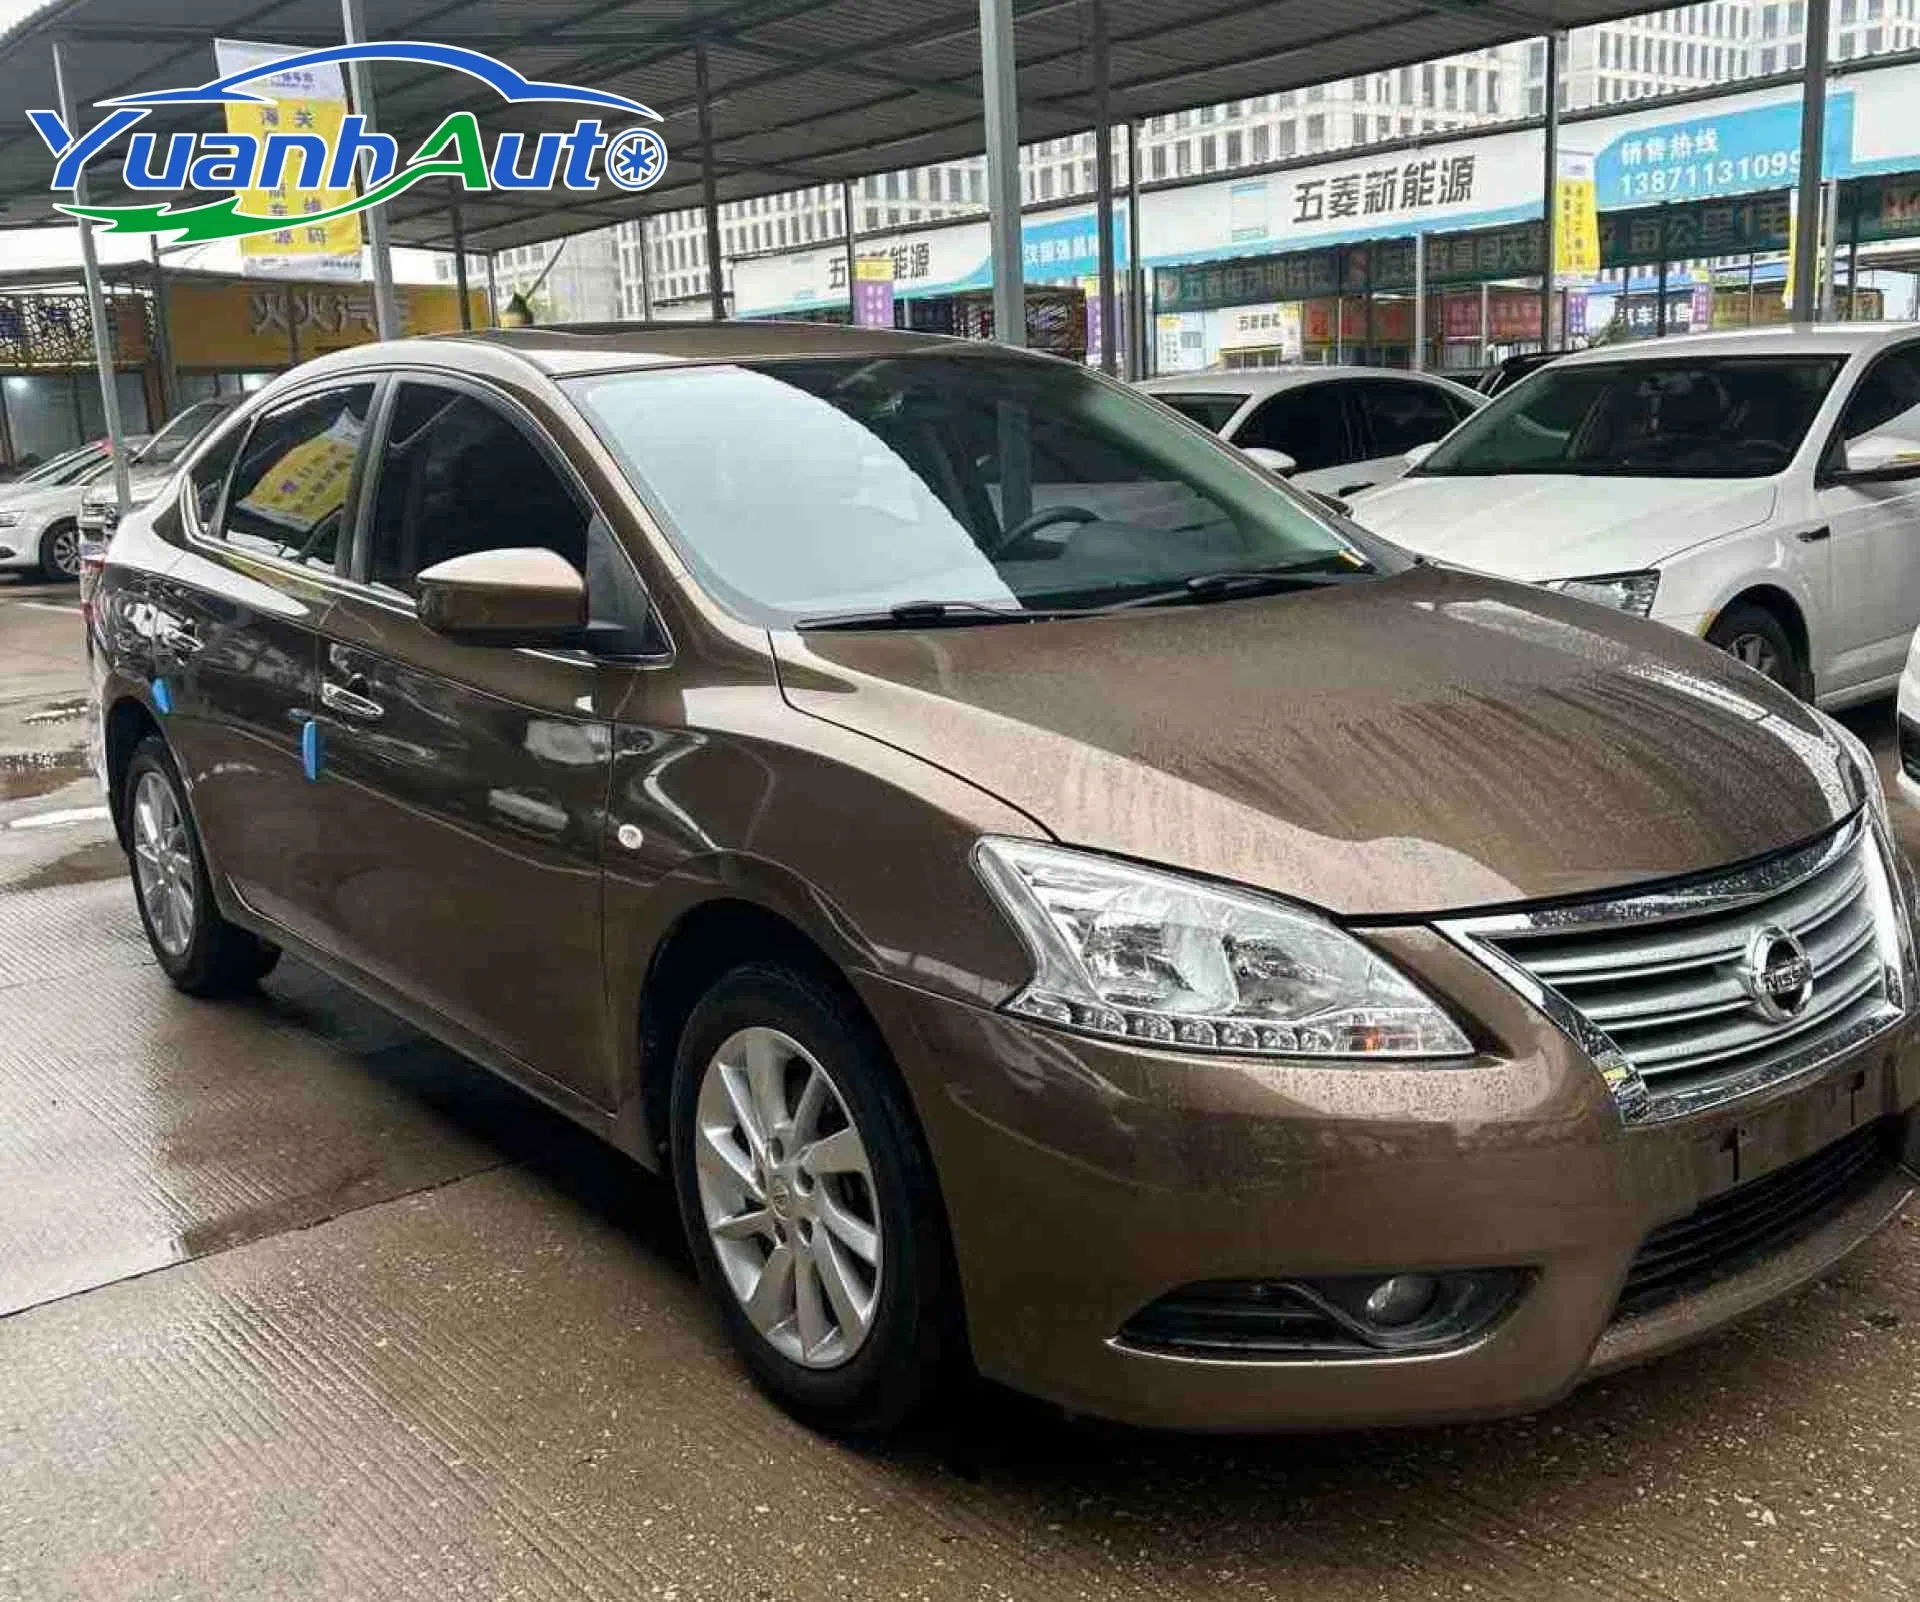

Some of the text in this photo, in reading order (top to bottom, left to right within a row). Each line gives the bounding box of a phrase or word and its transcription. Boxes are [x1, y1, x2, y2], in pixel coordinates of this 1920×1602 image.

[1621, 129, 1719, 166] 销售热线
[1293, 154, 1476, 224] 五菱新能源
[829, 242, 930, 290] 五能源
